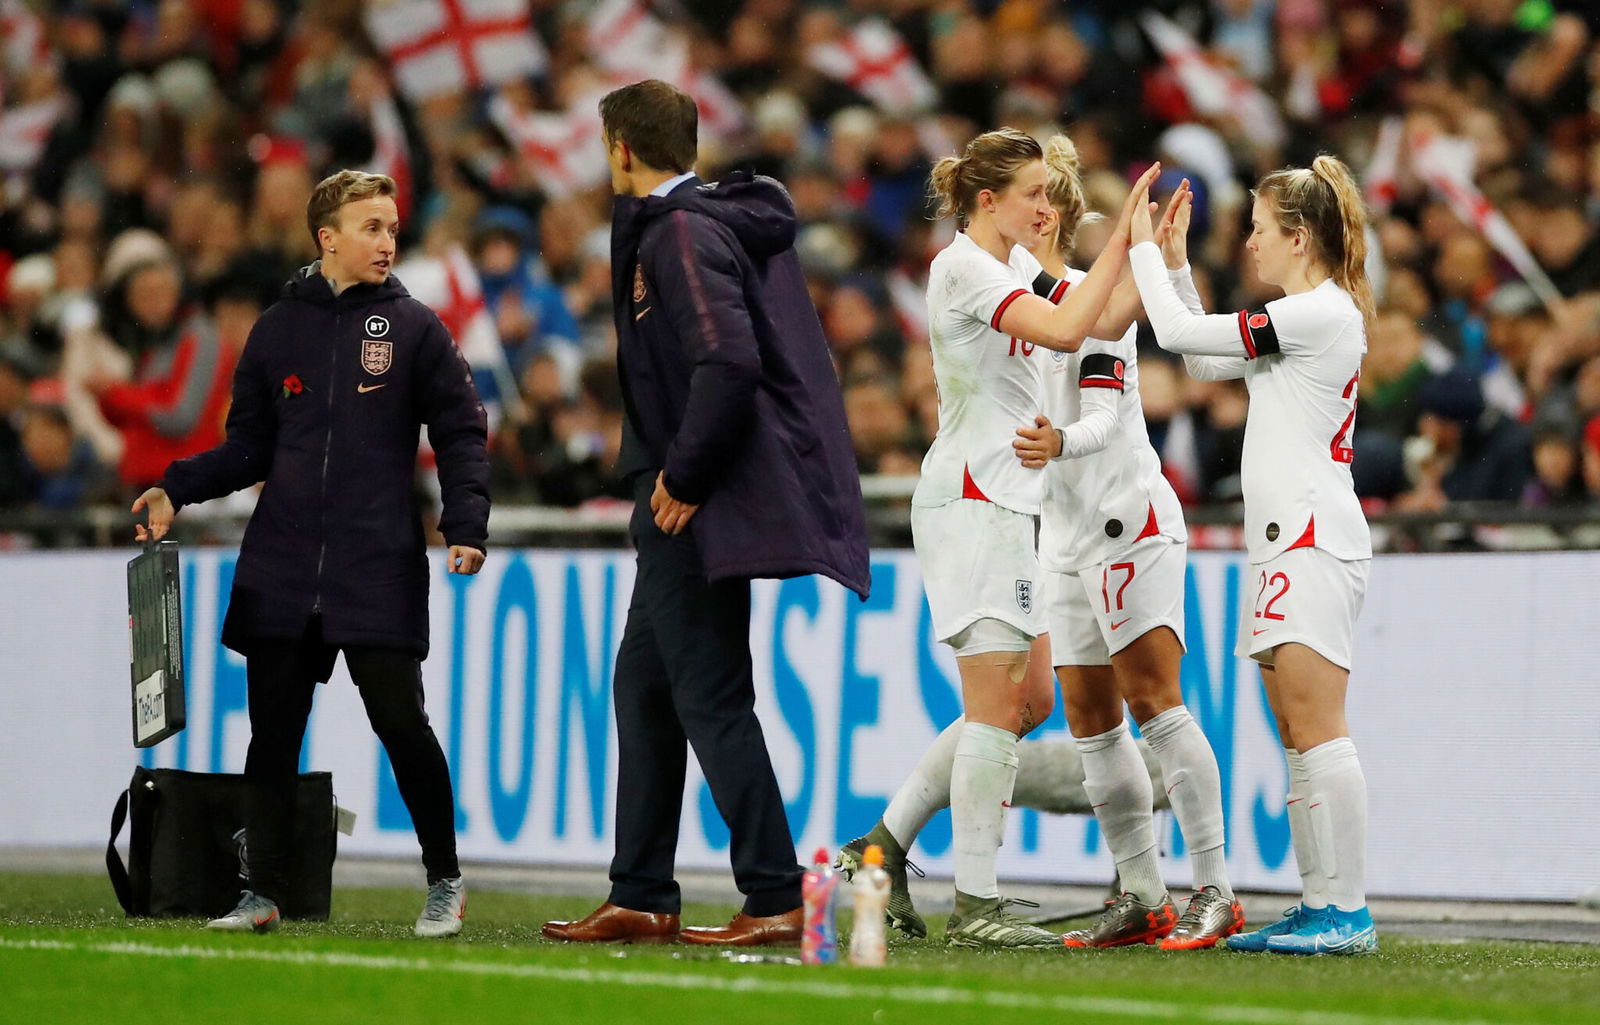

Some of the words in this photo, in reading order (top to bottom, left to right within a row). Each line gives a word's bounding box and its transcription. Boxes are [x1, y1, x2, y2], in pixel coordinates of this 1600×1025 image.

[370, 321, 384, 331] BT
[1102, 562, 1135, 613] 17
[1254, 569, 1290, 621] 22
